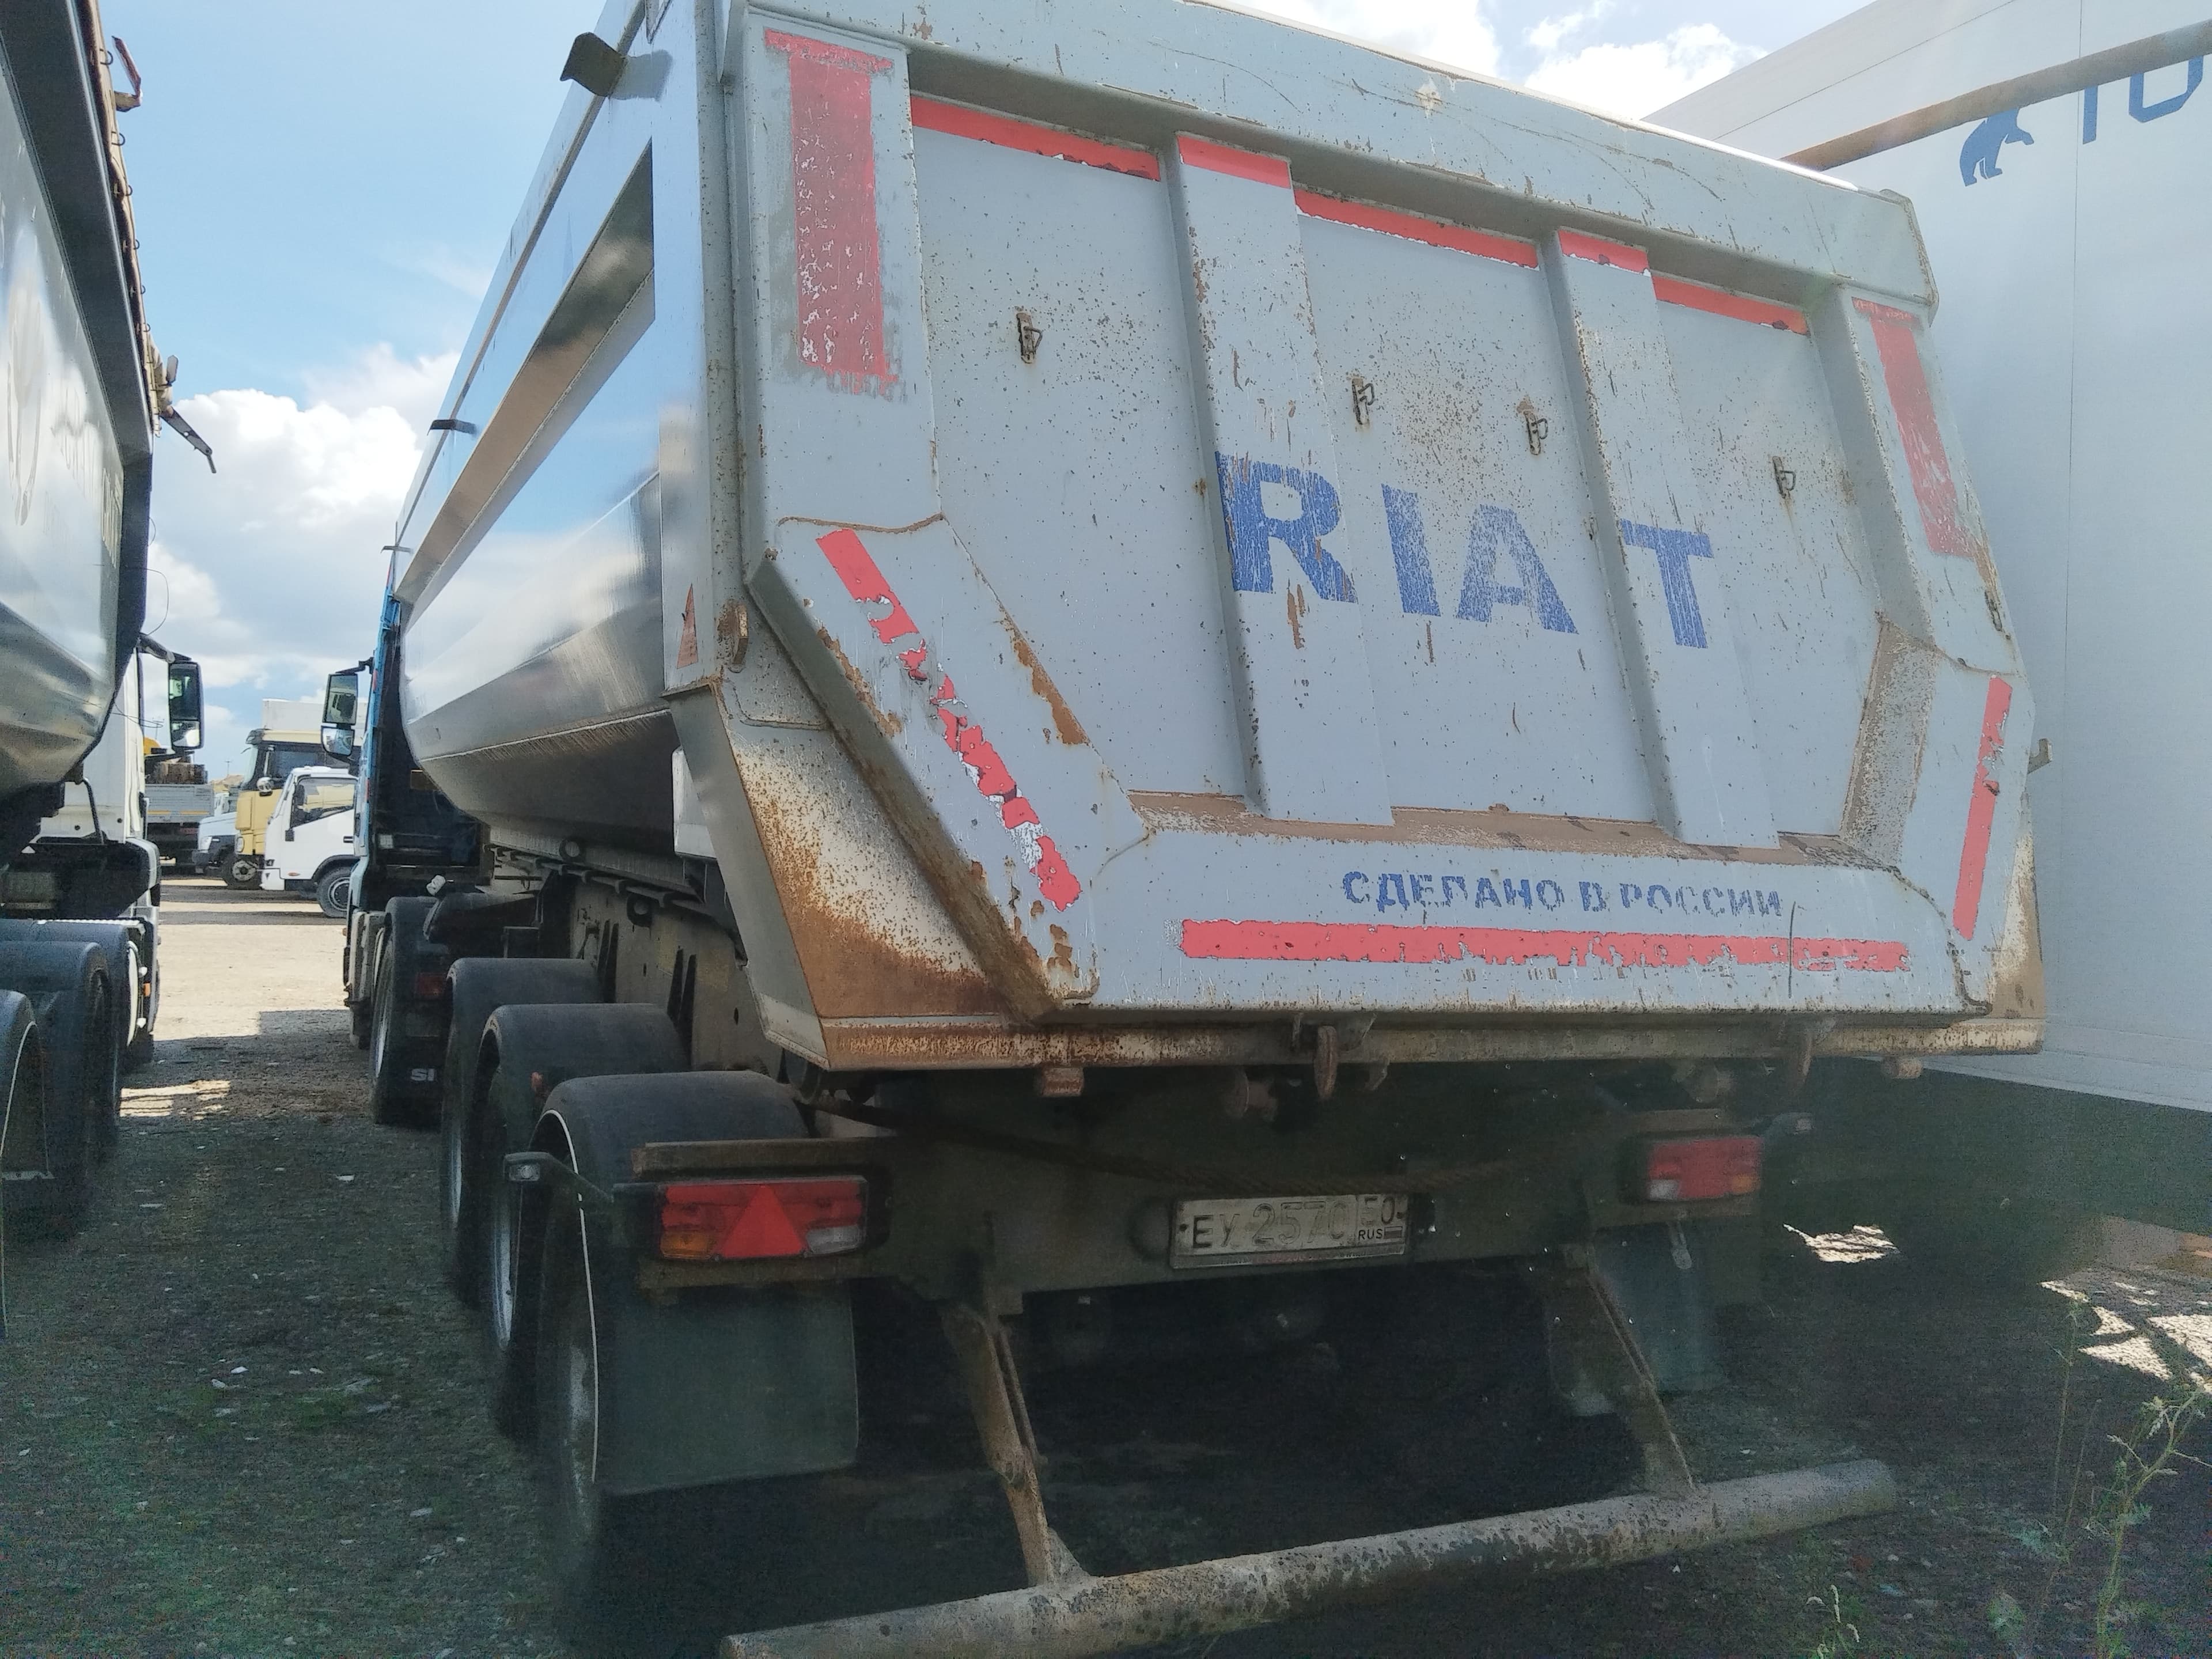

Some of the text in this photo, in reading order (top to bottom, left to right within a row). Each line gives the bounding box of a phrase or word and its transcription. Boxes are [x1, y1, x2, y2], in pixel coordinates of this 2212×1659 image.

[1215, 451, 1714, 649] RIAT
[1343, 871, 1783, 917] СДЕЛАНО В РОССИИ
[1358, 1228, 1383, 1241] RUS
